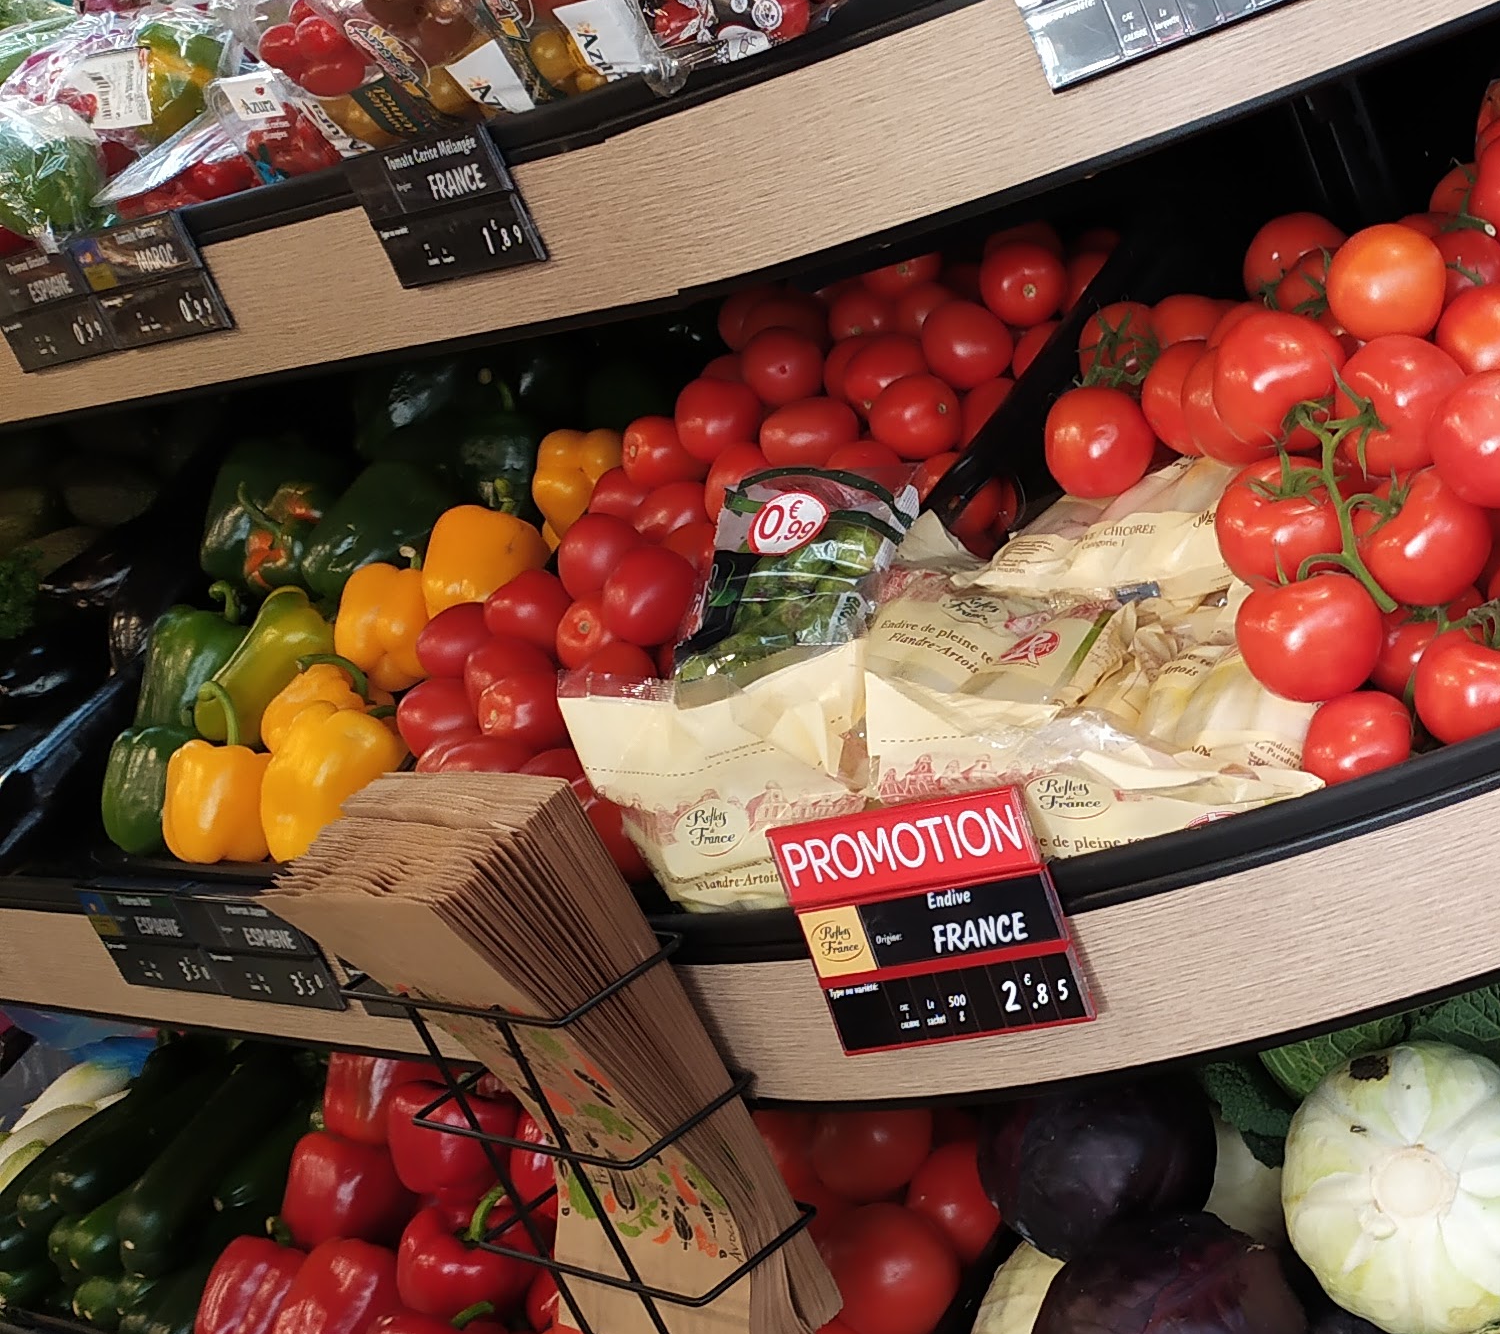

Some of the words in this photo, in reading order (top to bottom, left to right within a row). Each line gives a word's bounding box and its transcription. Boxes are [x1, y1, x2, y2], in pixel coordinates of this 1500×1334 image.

[426, 163, 487, 201] FRANCE
[135, 242, 178, 274] MAROC
[27, 271, 74, 304] ESPAGNE
[881, 619, 919, 632] Endive
[920, 622, 936, 635] de
[937, 628, 980, 654] pleine
[888, 631, 980, 675] Flandre-Artois
[1039, 796, 1102, 811] France
[688, 827, 736, 847] France
[780, 804, 1024, 888] PROMOTION
[1052, 835, 1070, 849] de
[926, 888, 972, 911] Endive
[134, 915, 184, 938] ESPAGNE
[241, 925, 297, 951] ESPAGNE
[931, 912, 1029, 954] FRANCE
[820, 937, 861, 957] France
[947, 993, 967, 1008] 500
